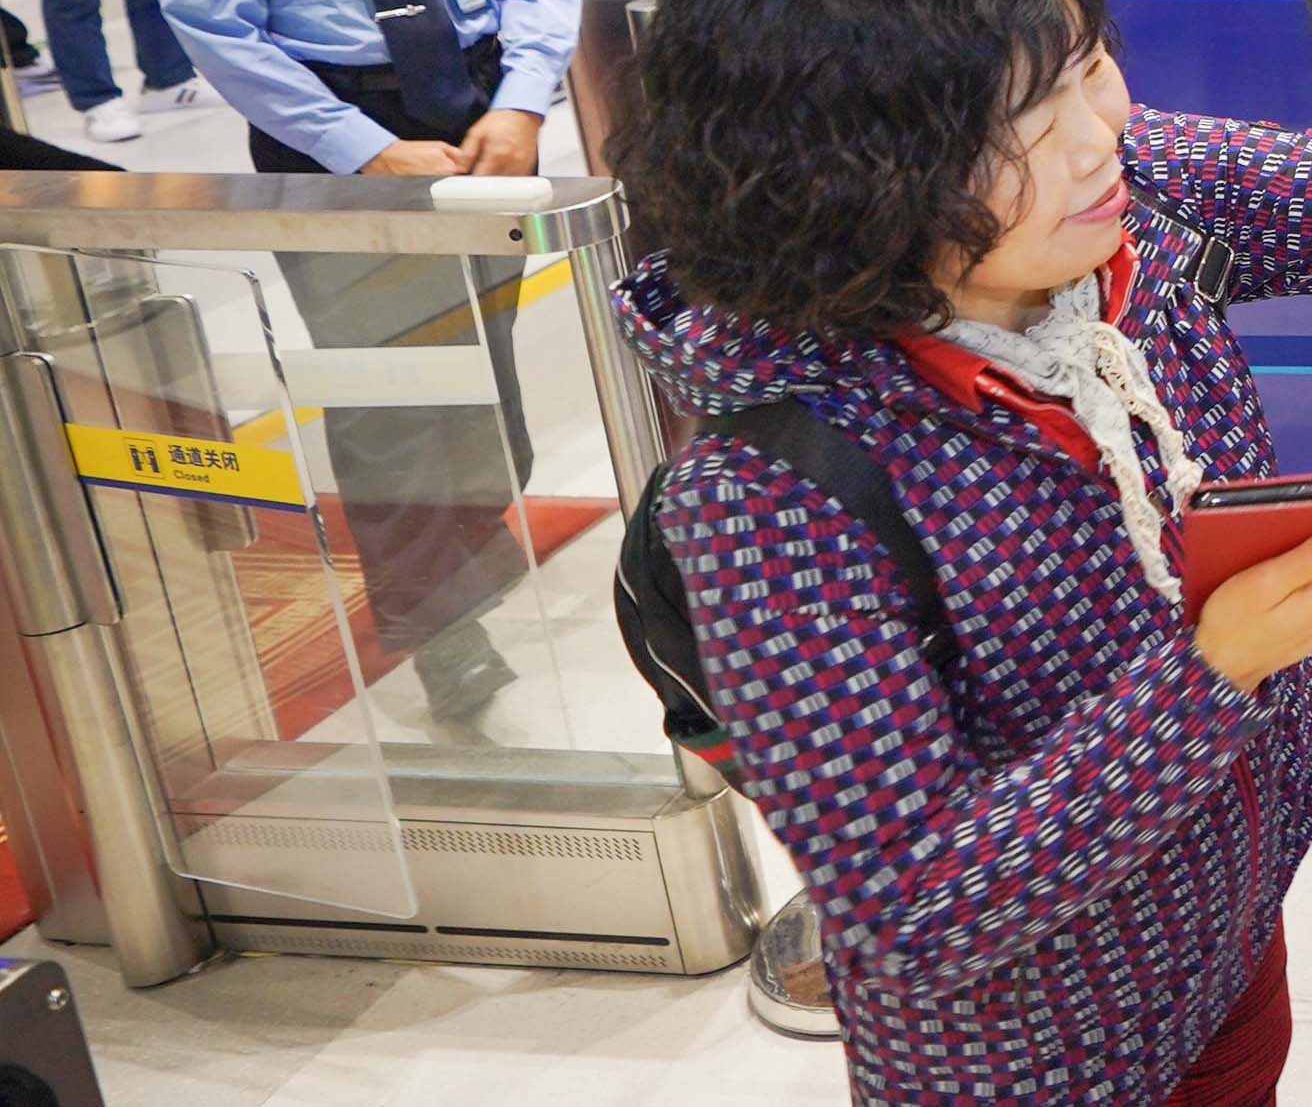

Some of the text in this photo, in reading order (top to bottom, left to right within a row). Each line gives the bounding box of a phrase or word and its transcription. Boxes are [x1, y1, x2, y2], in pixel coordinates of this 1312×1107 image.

[168, 444, 240, 472] 通道关闭
[173, 469, 210, 483] Closed
